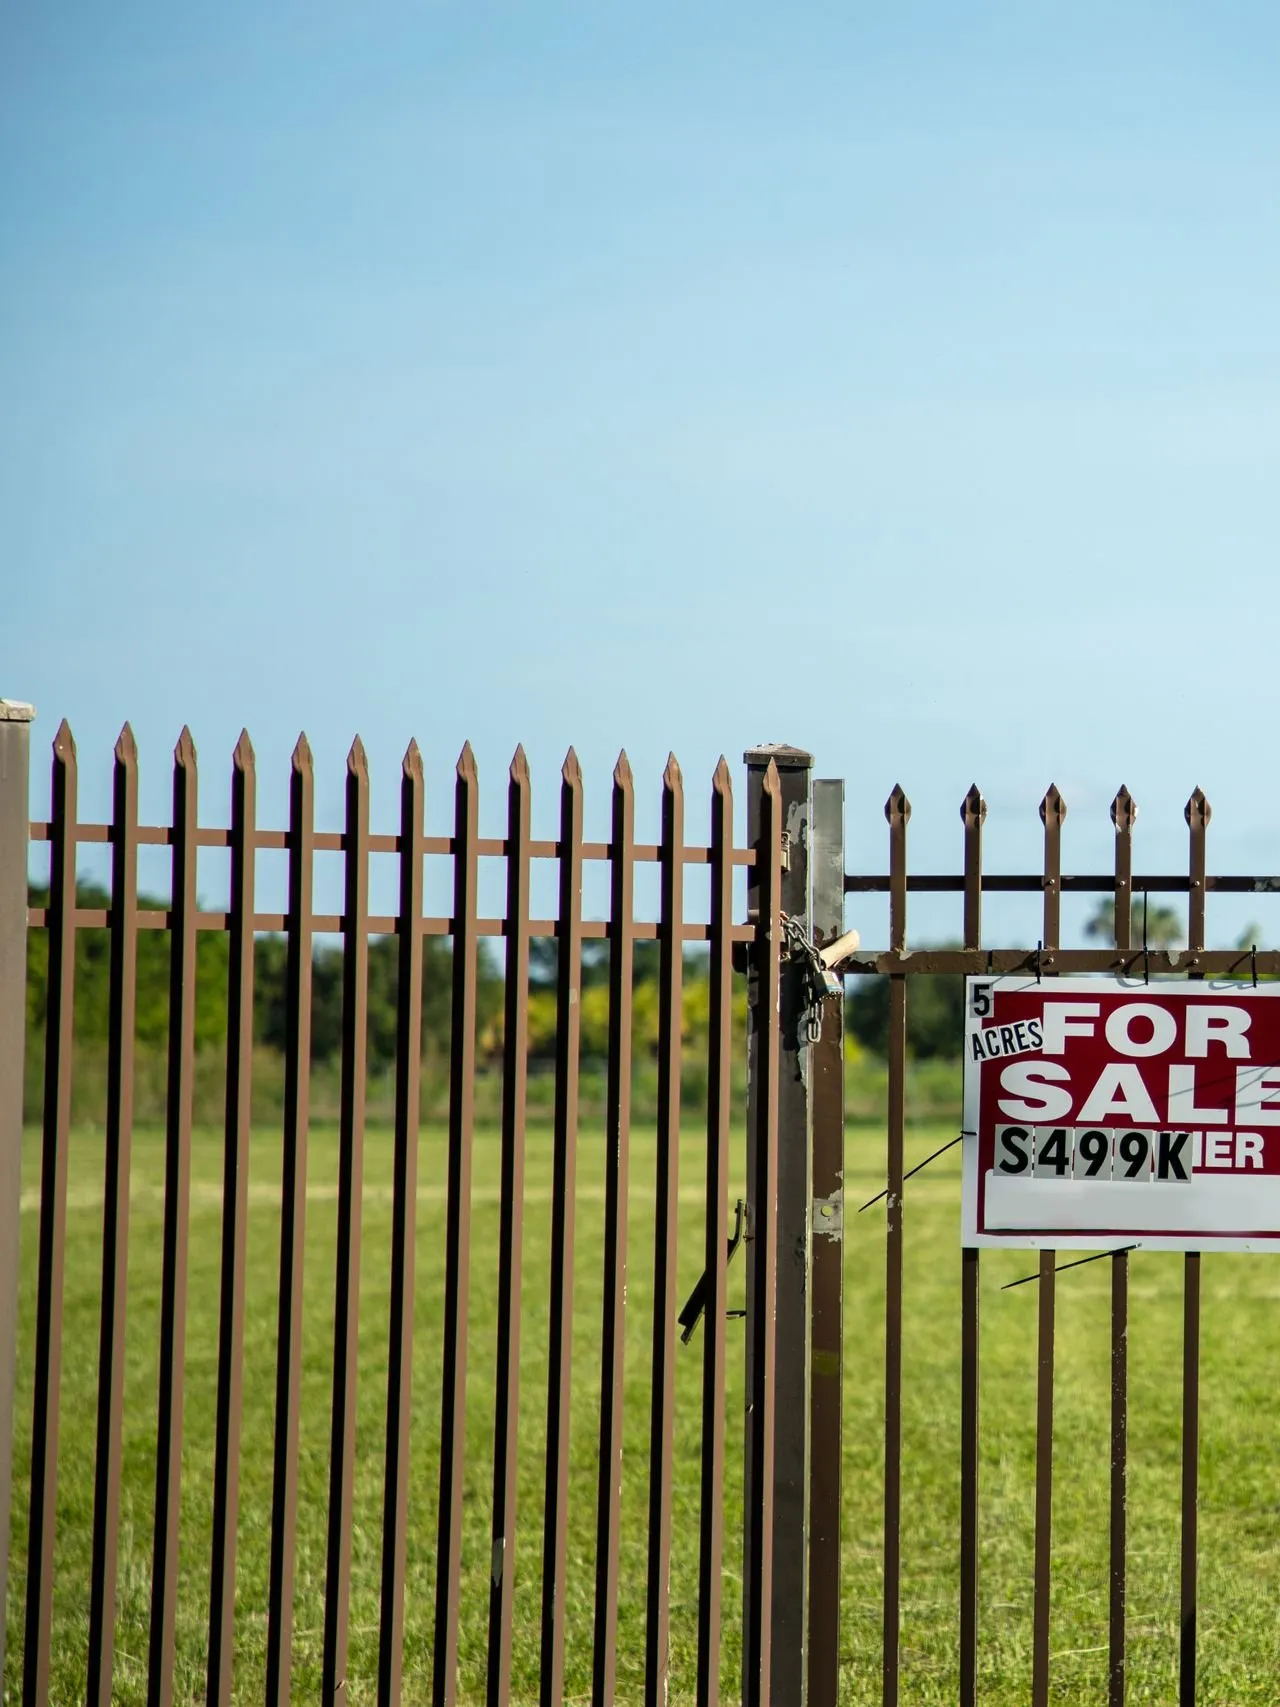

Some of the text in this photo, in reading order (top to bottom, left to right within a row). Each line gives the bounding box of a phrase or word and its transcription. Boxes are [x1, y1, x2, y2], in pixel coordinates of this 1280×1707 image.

[974, 984, 990, 1016] 5
[972, 1021, 1043, 1061] ACRES
[1042, 1001, 1252, 1058] FOR
